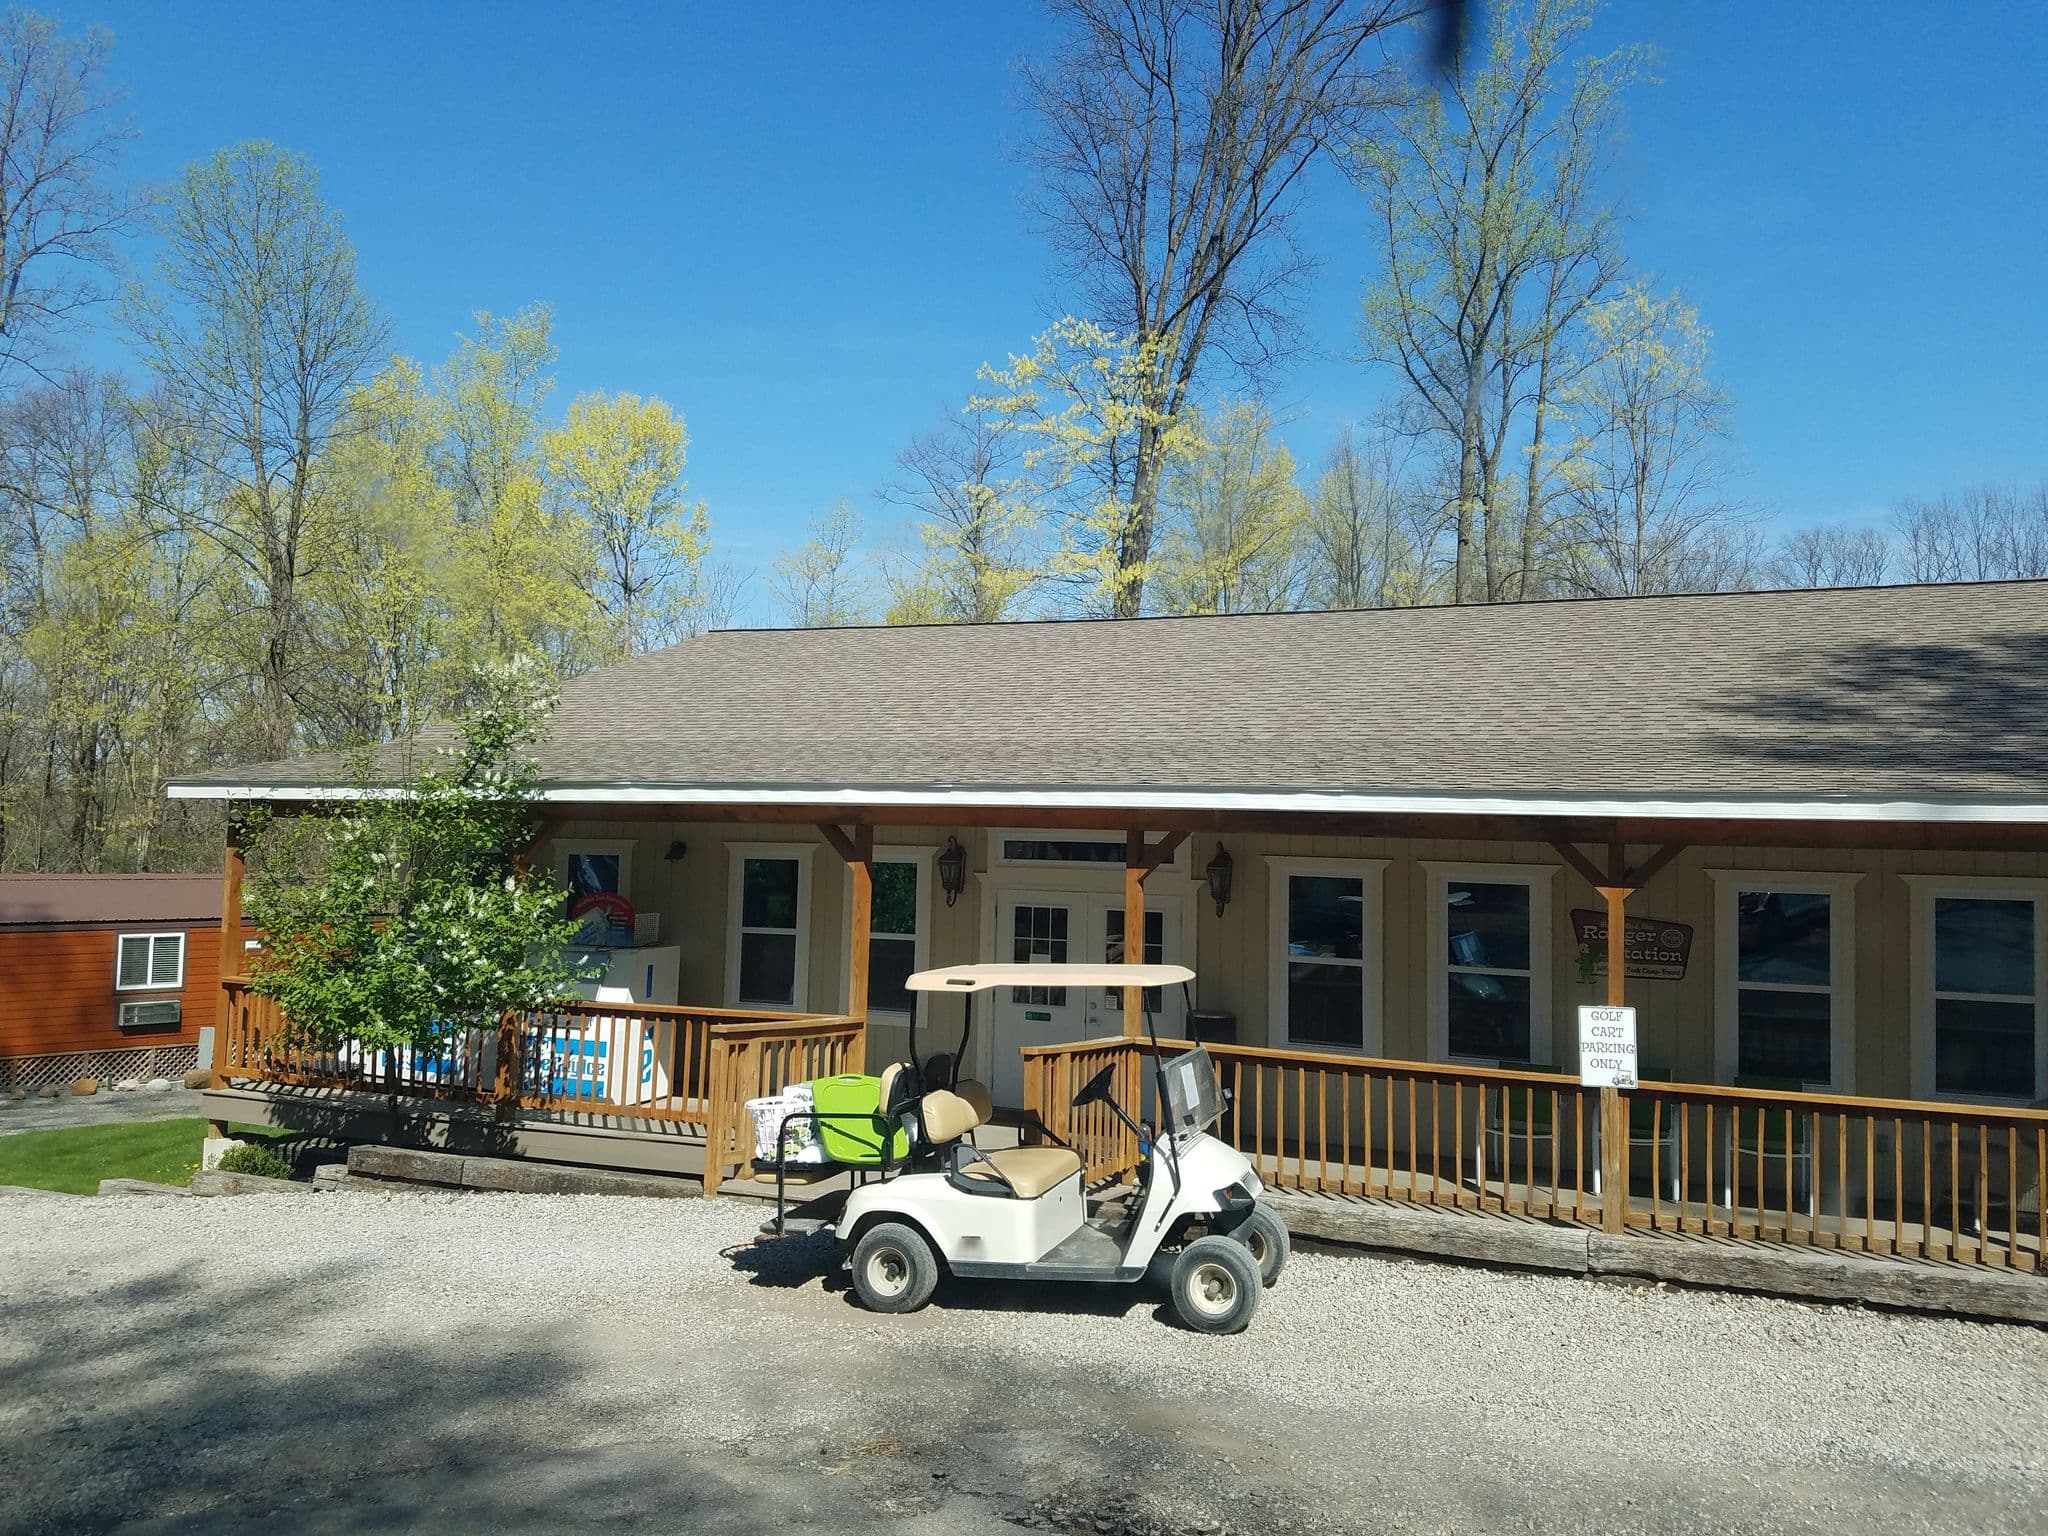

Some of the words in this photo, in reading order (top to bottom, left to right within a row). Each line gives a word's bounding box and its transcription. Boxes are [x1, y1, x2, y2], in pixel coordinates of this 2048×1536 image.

[1582, 925, 1657, 945] Rager
[1624, 947, 1682, 961] tation
[1591, 1011, 1623, 1022] GOLF
[1591, 1027, 1624, 1038] CART
[1582, 1042, 1634, 1054] PARKING
[1590, 1058, 1623, 1069] ONLY
